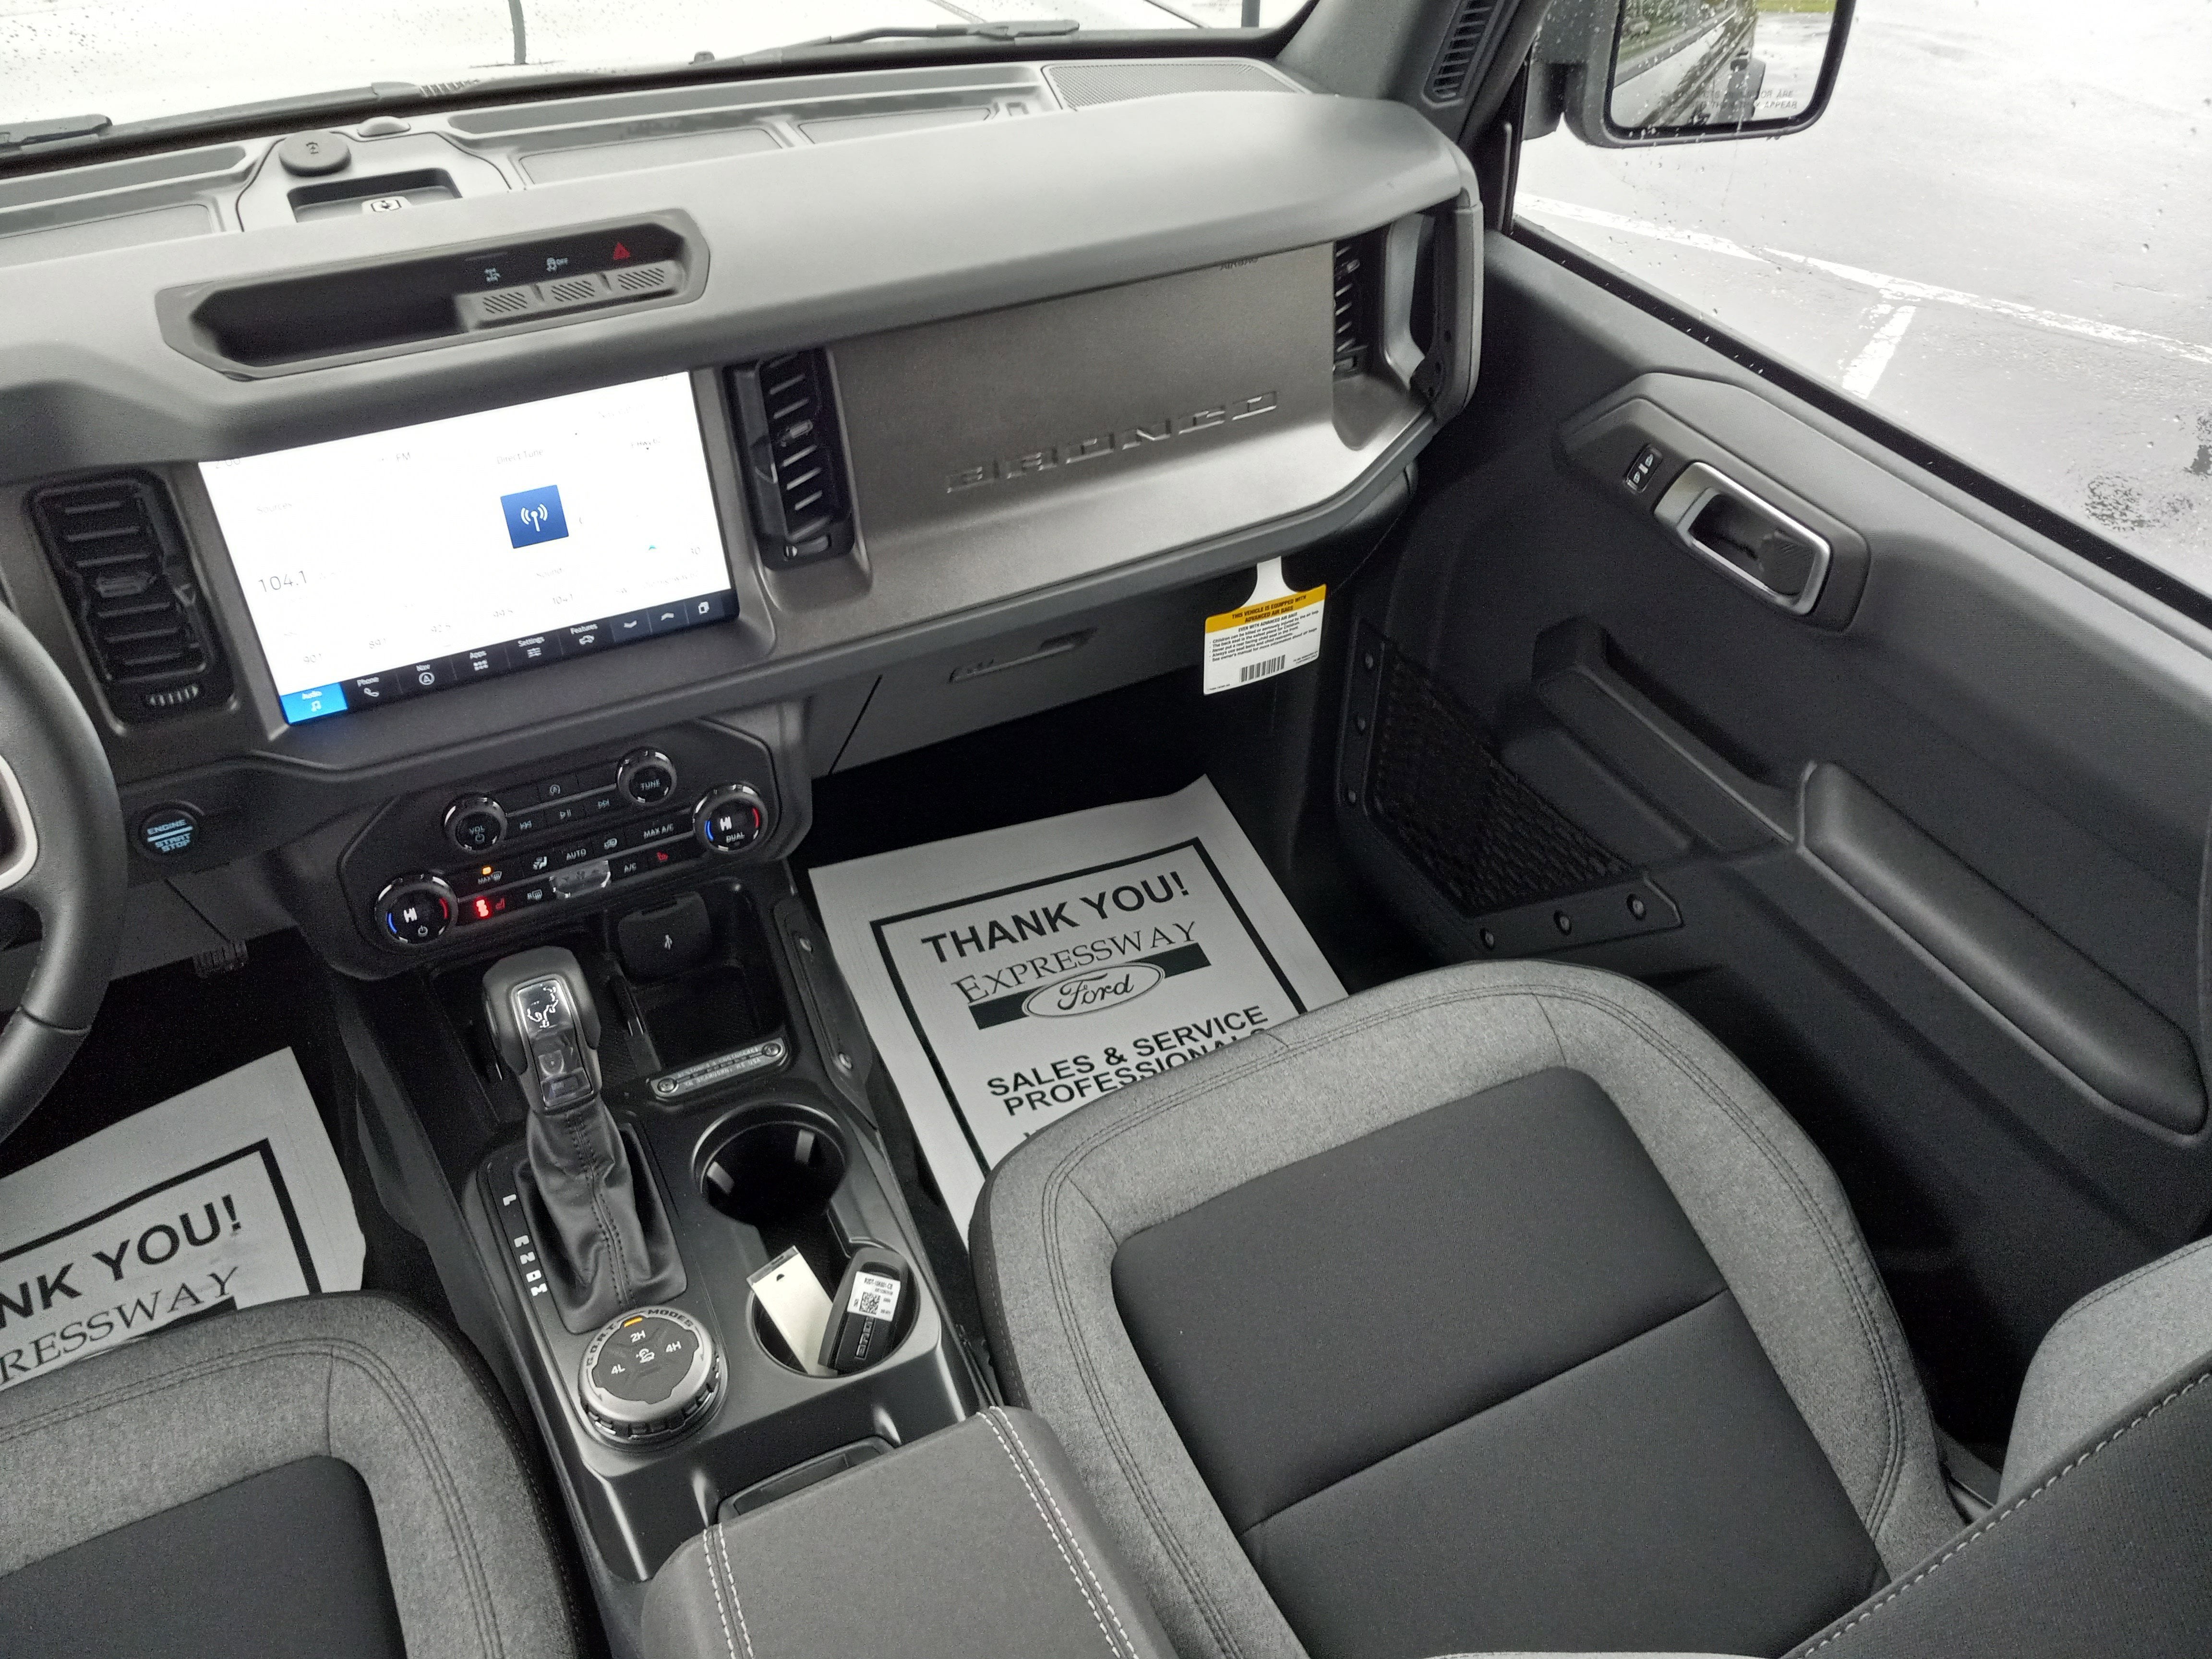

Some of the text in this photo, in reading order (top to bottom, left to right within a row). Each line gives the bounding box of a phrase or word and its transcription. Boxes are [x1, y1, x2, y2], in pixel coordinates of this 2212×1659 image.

[946, 391, 1277, 493] BRONCO
[259, 570, 307, 594] 104.1
[1244, 607, 1263, 615] VEHICLE
[1271, 599, 1293, 609] EQUIPPED
[1245, 612, 1270, 622] ADVANCED
[1260, 617, 1280, 625] ADVANCED
[302, 624, 598, 700] Audio Phone Nav Apps Settings Features
[640, 779, 661, 790] TUNE
[147, 819, 187, 835] ENGINE
[469, 825, 485, 835] VOL
[644, 823, 674, 839] MAX A/C
[155, 833, 191, 848] START
[726, 832, 745, 843] DUAL
[161, 839, 190, 852] STOP
[566, 848, 587, 861] AUTO
[624, 863, 637, 873] A/C
[478, 876, 491, 885] MAX
[921, 871, 1189, 963] THANK YOU!
[951, 921, 1195, 1004] EXPRESSWAY
[1057, 973, 1134, 1010] Ford
[987, 1005, 1269, 1096] SALES & SERVICE
[1003, 1028, 1266, 1116] PROFESSION
[92, 1194, 242, 1281] YOU!
[520, 1251, 535, 1264] N
[526, 1270, 541, 1282] D
[530, 1283, 548, 1296] M
[648, 1309, 693, 1327] MODES
[630, 1330, 646, 1343] 2H
[666, 1341, 682, 1353] 4H
[611, 1364, 625, 1374] 4L
